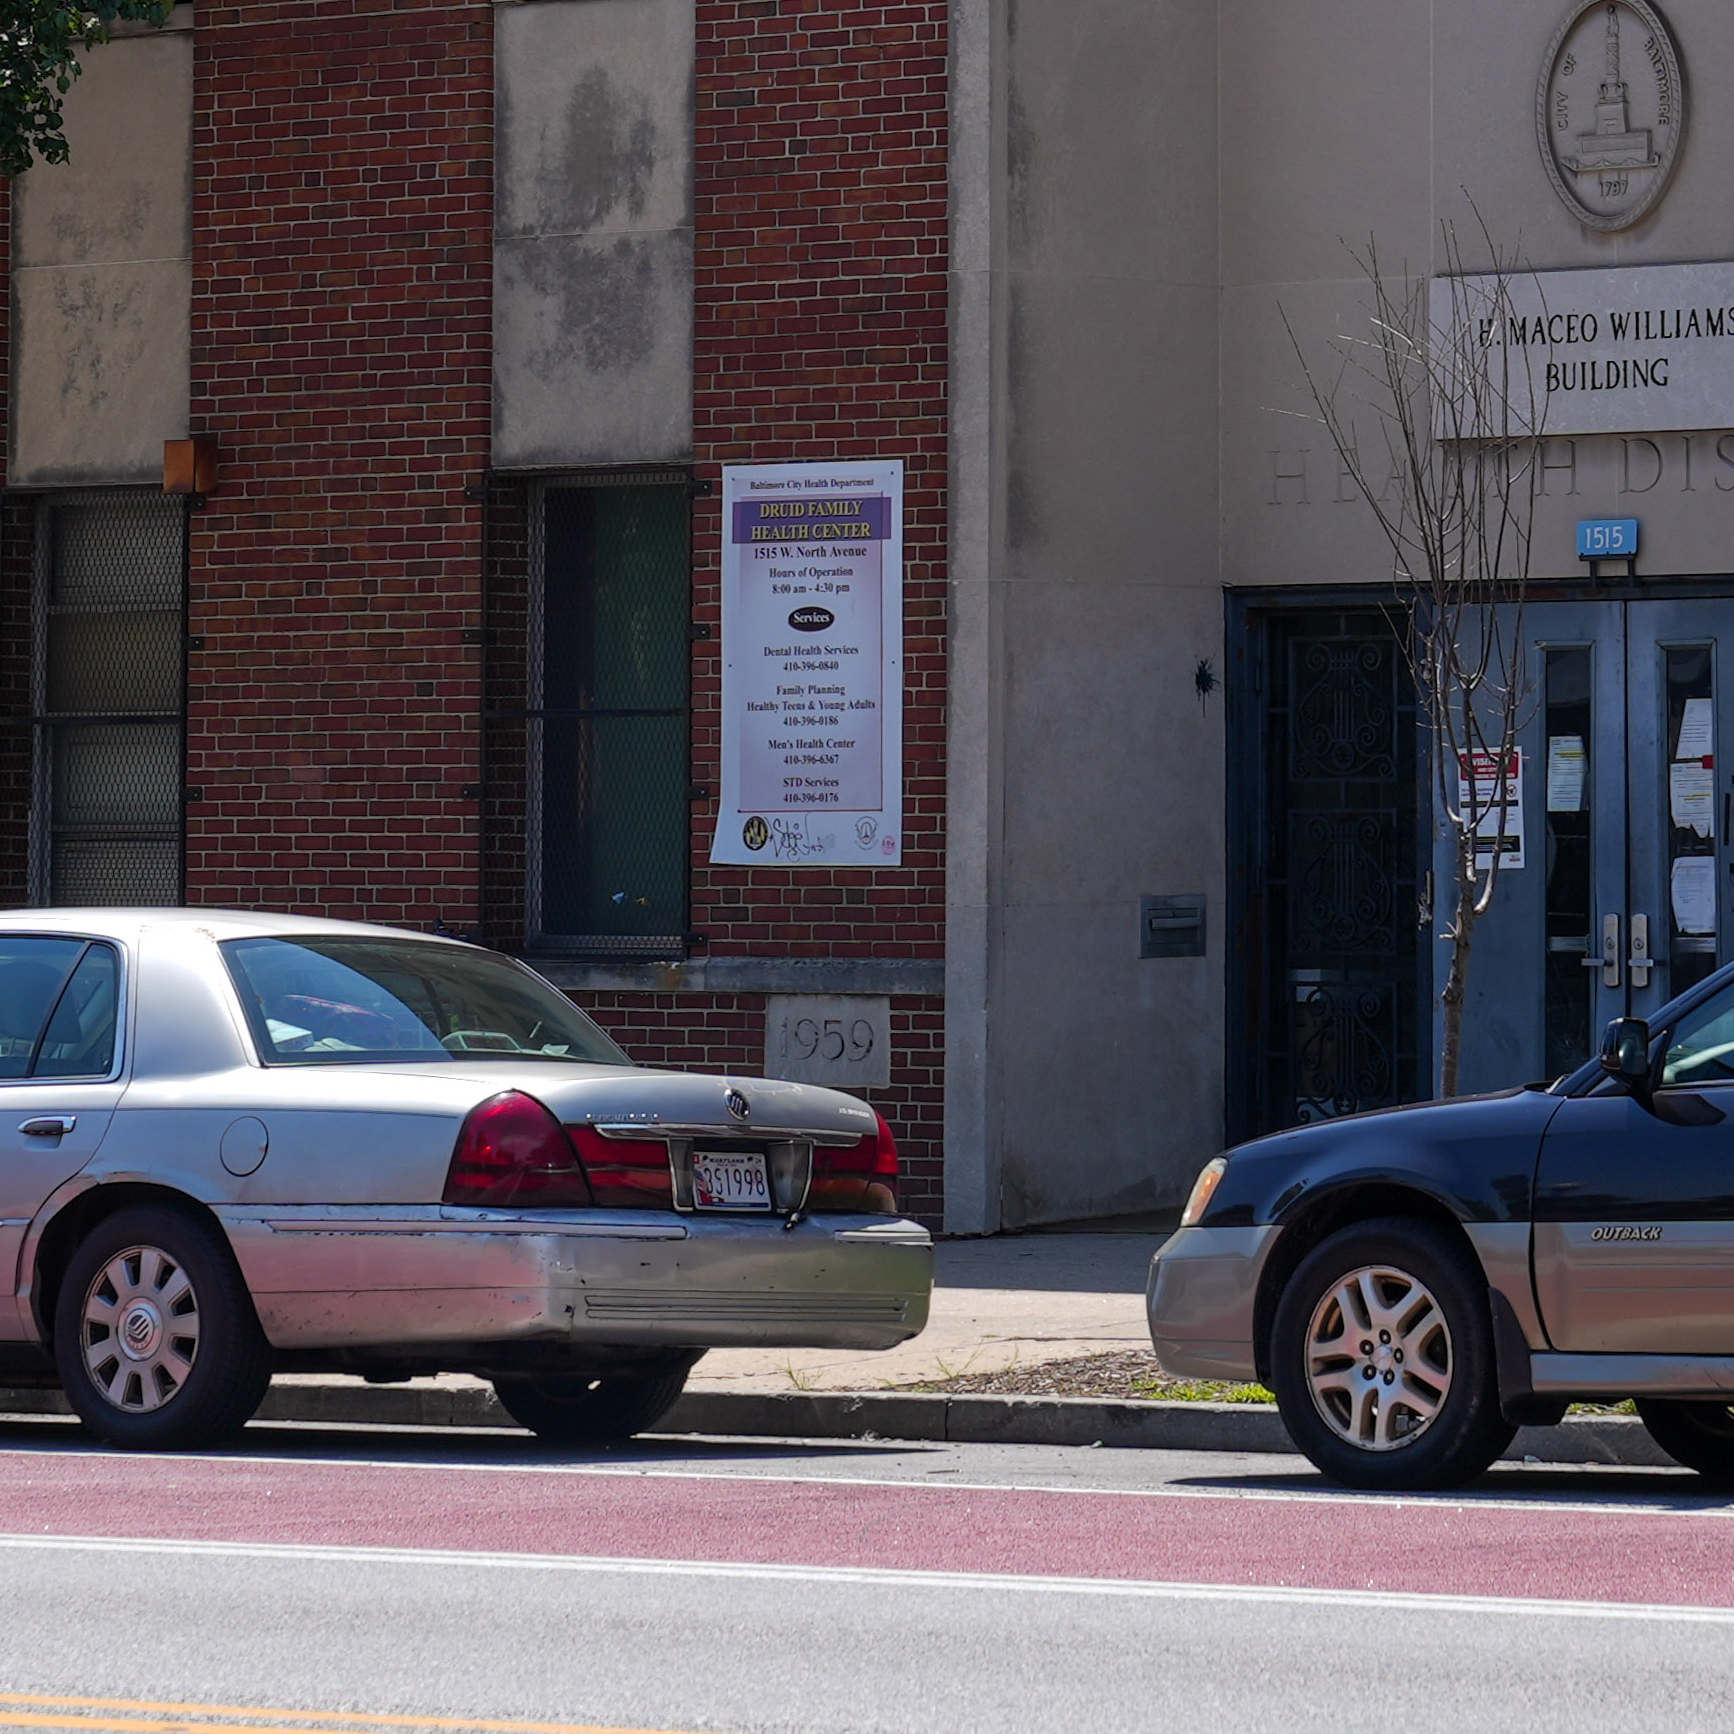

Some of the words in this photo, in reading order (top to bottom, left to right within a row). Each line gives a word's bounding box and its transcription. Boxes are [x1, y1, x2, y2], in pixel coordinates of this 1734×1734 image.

[1562, 52, 1576, 76] OF
[1643, 37, 1671, 126] BALTIMORE
[1556, 91, 1569, 130] CITY
[1509, 313, 1598, 346] MACEO
[1546, 358, 1669, 392] BUILDING
[750, 480, 784, 490] Baltimore
[787, 480, 802, 490] City
[804, 479, 828, 488] Health
[830, 478, 874, 490] Department
[760, 503, 804, 518] DRUID
[808, 500, 863, 516] FAMILY
[750, 524, 809, 540] HEALTH
[812, 522, 872, 538] CENTER
[1584, 526, 1624, 550] 1515
[754, 548, 778, 559] 1515
[780, 547, 794, 558] W.
[797, 546, 826, 558] North
[830, 546, 867, 557] Avenue
[770, 568, 796, 578] Hours
[798, 567, 808, 577] of
[808, 566, 854, 579] Operation
[772, 584, 791, 594] 8:00
[794, 586, 806, 594] am
[814, 583, 834, 592] 4:30
[836, 584, 850, 594] pm
[794, 612, 830, 624] Services
[764, 646, 792, 656] Dental
[794, 646, 822, 656] Health
[824, 645, 859, 654] Services
[776, 686, 804, 697] Family
[808, 684, 846, 696] Planning
[747, 702, 780, 713] Healthy
[782, 701, 806, 711] Teens
[808, 701, 816, 710] &
[818, 700, 846, 712] Young
[848, 699, 876, 709] Adults
[768, 740, 794, 750] Men's
[796, 738, 824, 748] Health
[826, 738, 856, 748] Center
[783, 777, 802, 788] STD
[804, 776, 840, 787] Services
[780, 1018, 874, 1062] 1959
[1591, 1226, 1662, 1241] OUTBACK
